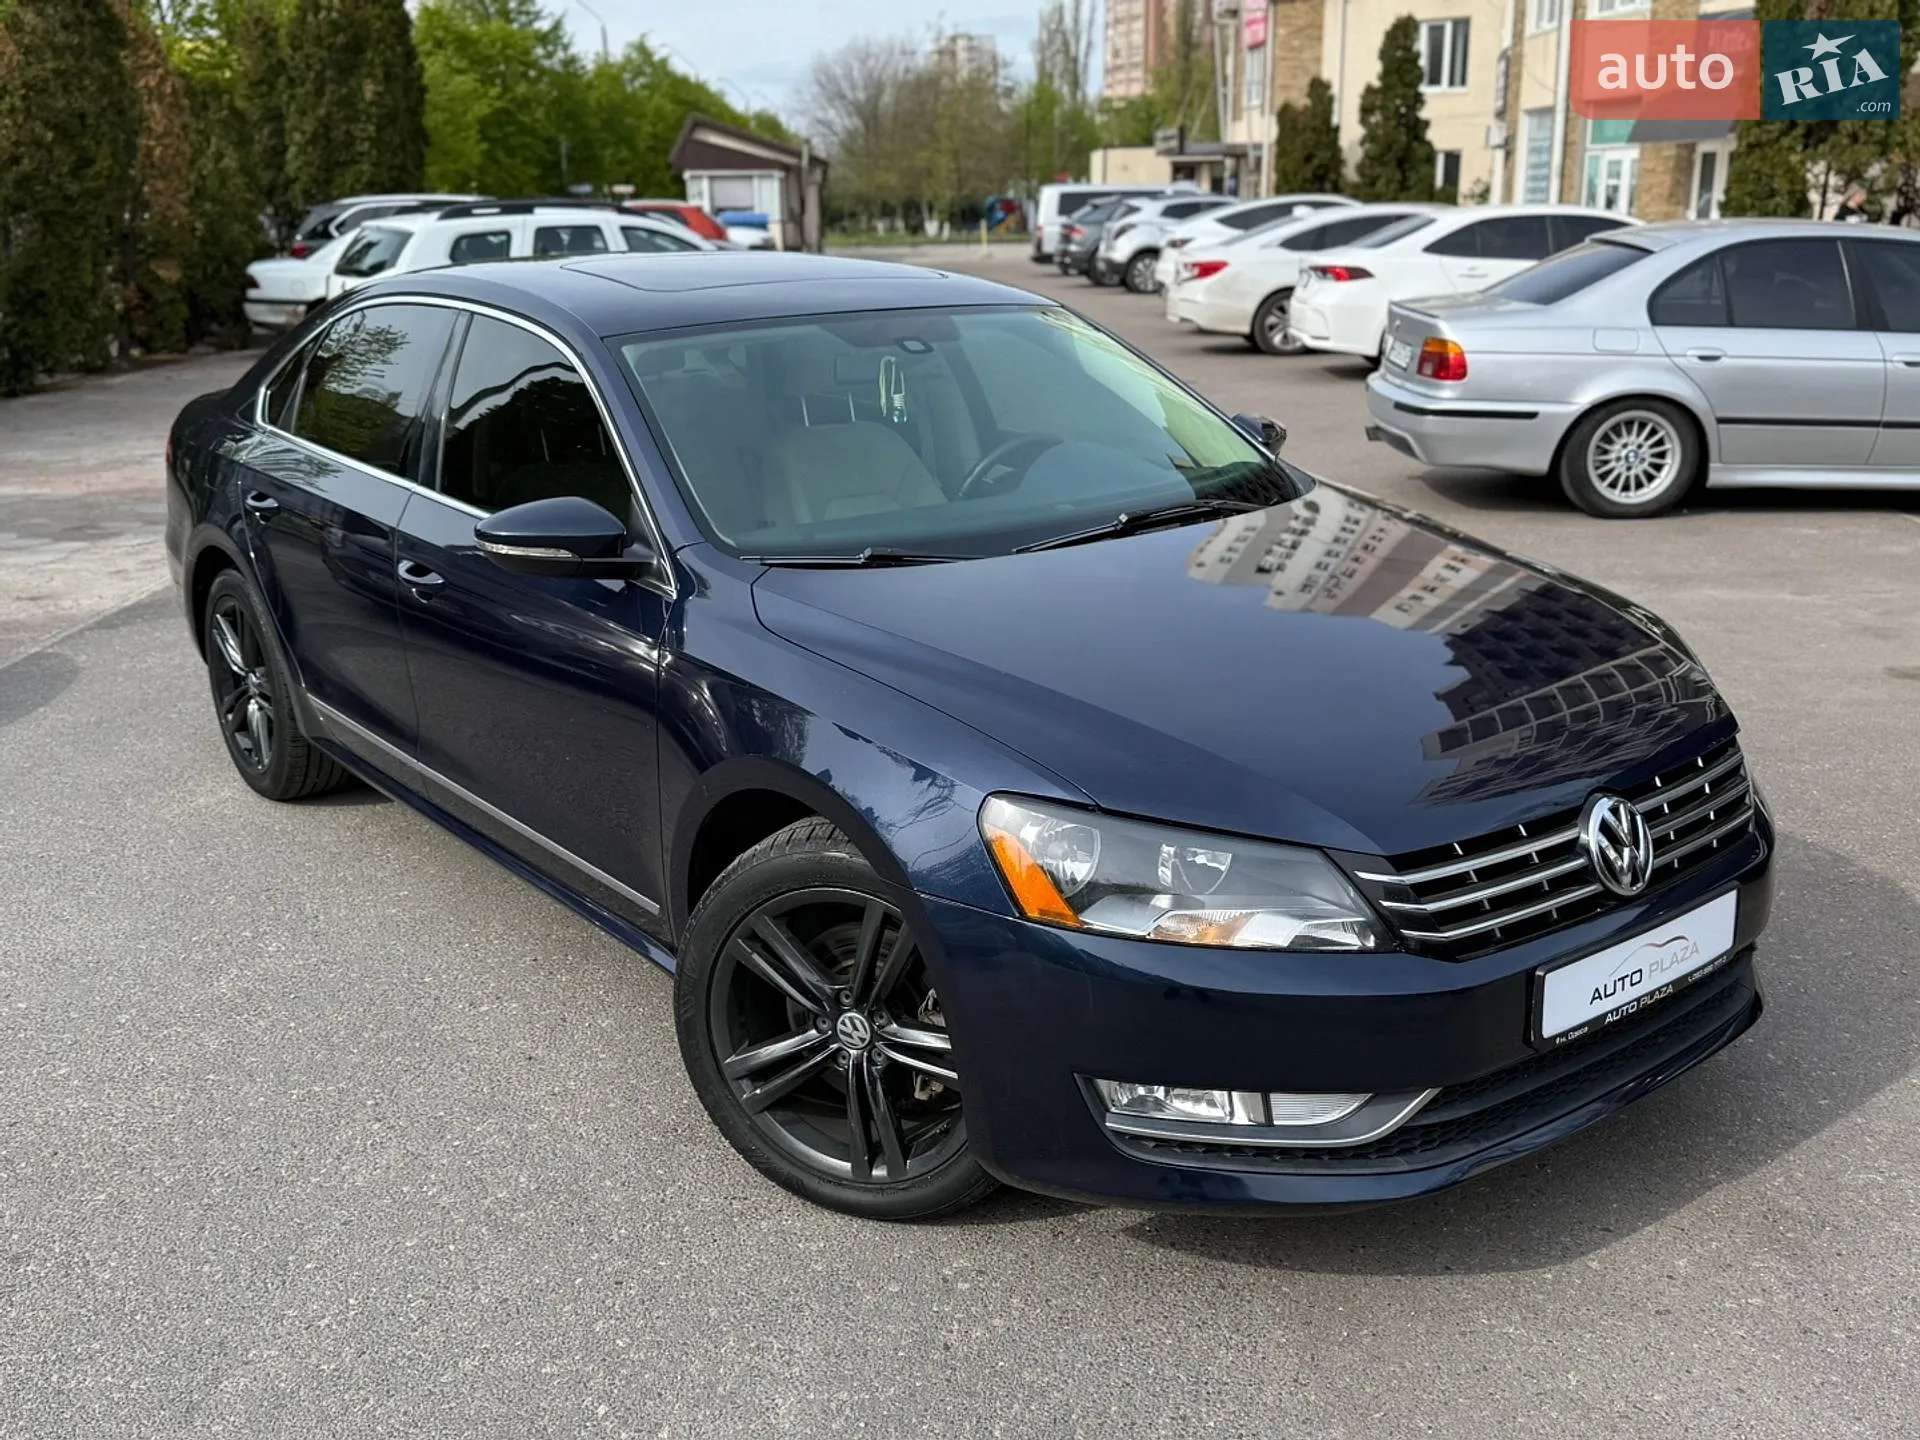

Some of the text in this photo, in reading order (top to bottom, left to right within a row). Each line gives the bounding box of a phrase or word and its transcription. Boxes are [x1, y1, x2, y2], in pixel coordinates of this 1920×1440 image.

[1589, 968, 1643, 1005] AUTO
[1648, 942, 1700, 979] PLAZA
[1604, 984, 1674, 1025] AUTO PLAZA
